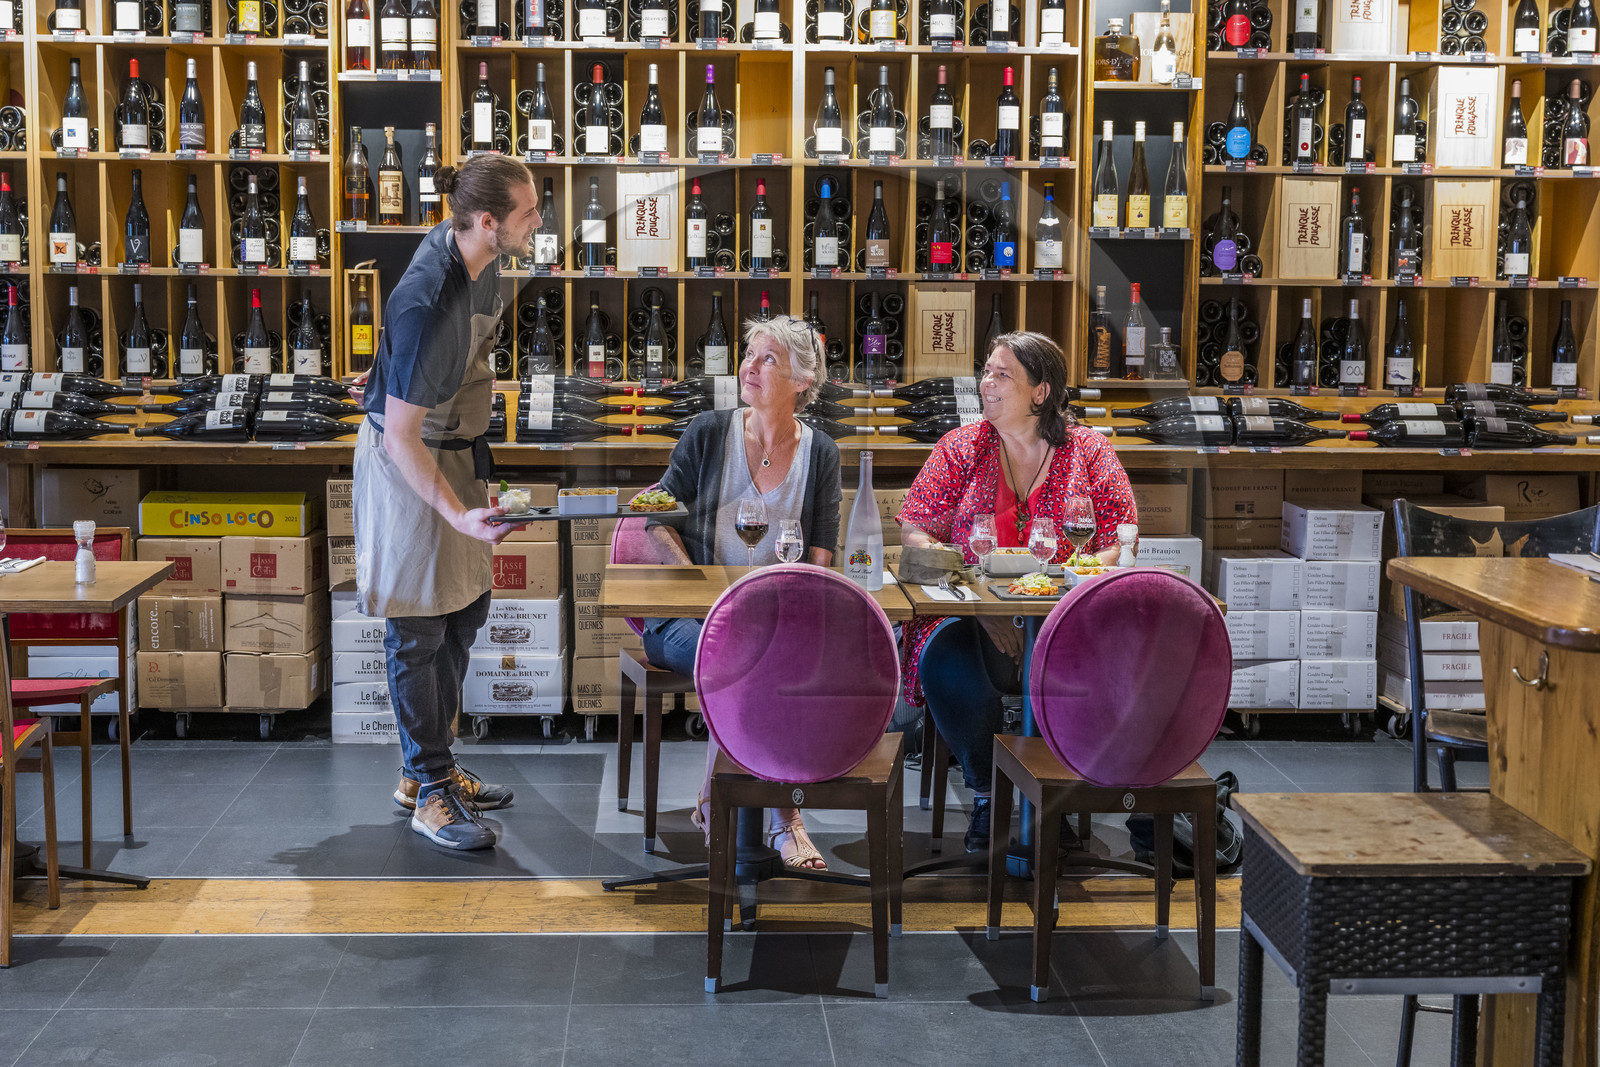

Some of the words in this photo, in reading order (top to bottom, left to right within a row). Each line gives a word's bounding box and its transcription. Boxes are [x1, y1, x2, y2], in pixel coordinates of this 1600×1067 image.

[1468, 96, 1477, 136] FOUGASSE
[649, 197, 658, 237] FOUGASSE
[1312, 206, 1320, 246] FOUGASSE
[1463, 207, 1472, 247] FOUGASSE
[945, 312, 956, 352] FOUGASSE
[330, 484, 342, 493] MAS
[330, 500, 353, 508] QUERNE
[227, 510, 274, 529] LOCO
[574, 532, 599, 540] QUERNES
[332, 540, 345, 548] MAS
[493, 573, 523, 587] CASTEL
[577, 589, 600, 597] QUERNES
[578, 606, 591, 614] MAS
[579, 621, 603, 630] QUERNES
[362, 630, 370, 638] Le
[362, 661, 370, 669] Le
[577, 685, 589, 693] MAS
[590, 685, 602, 693] DES
[361, 692, 370, 700] Le
[578, 700, 602, 708] QUERNES
[361, 722, 370, 730] Le
